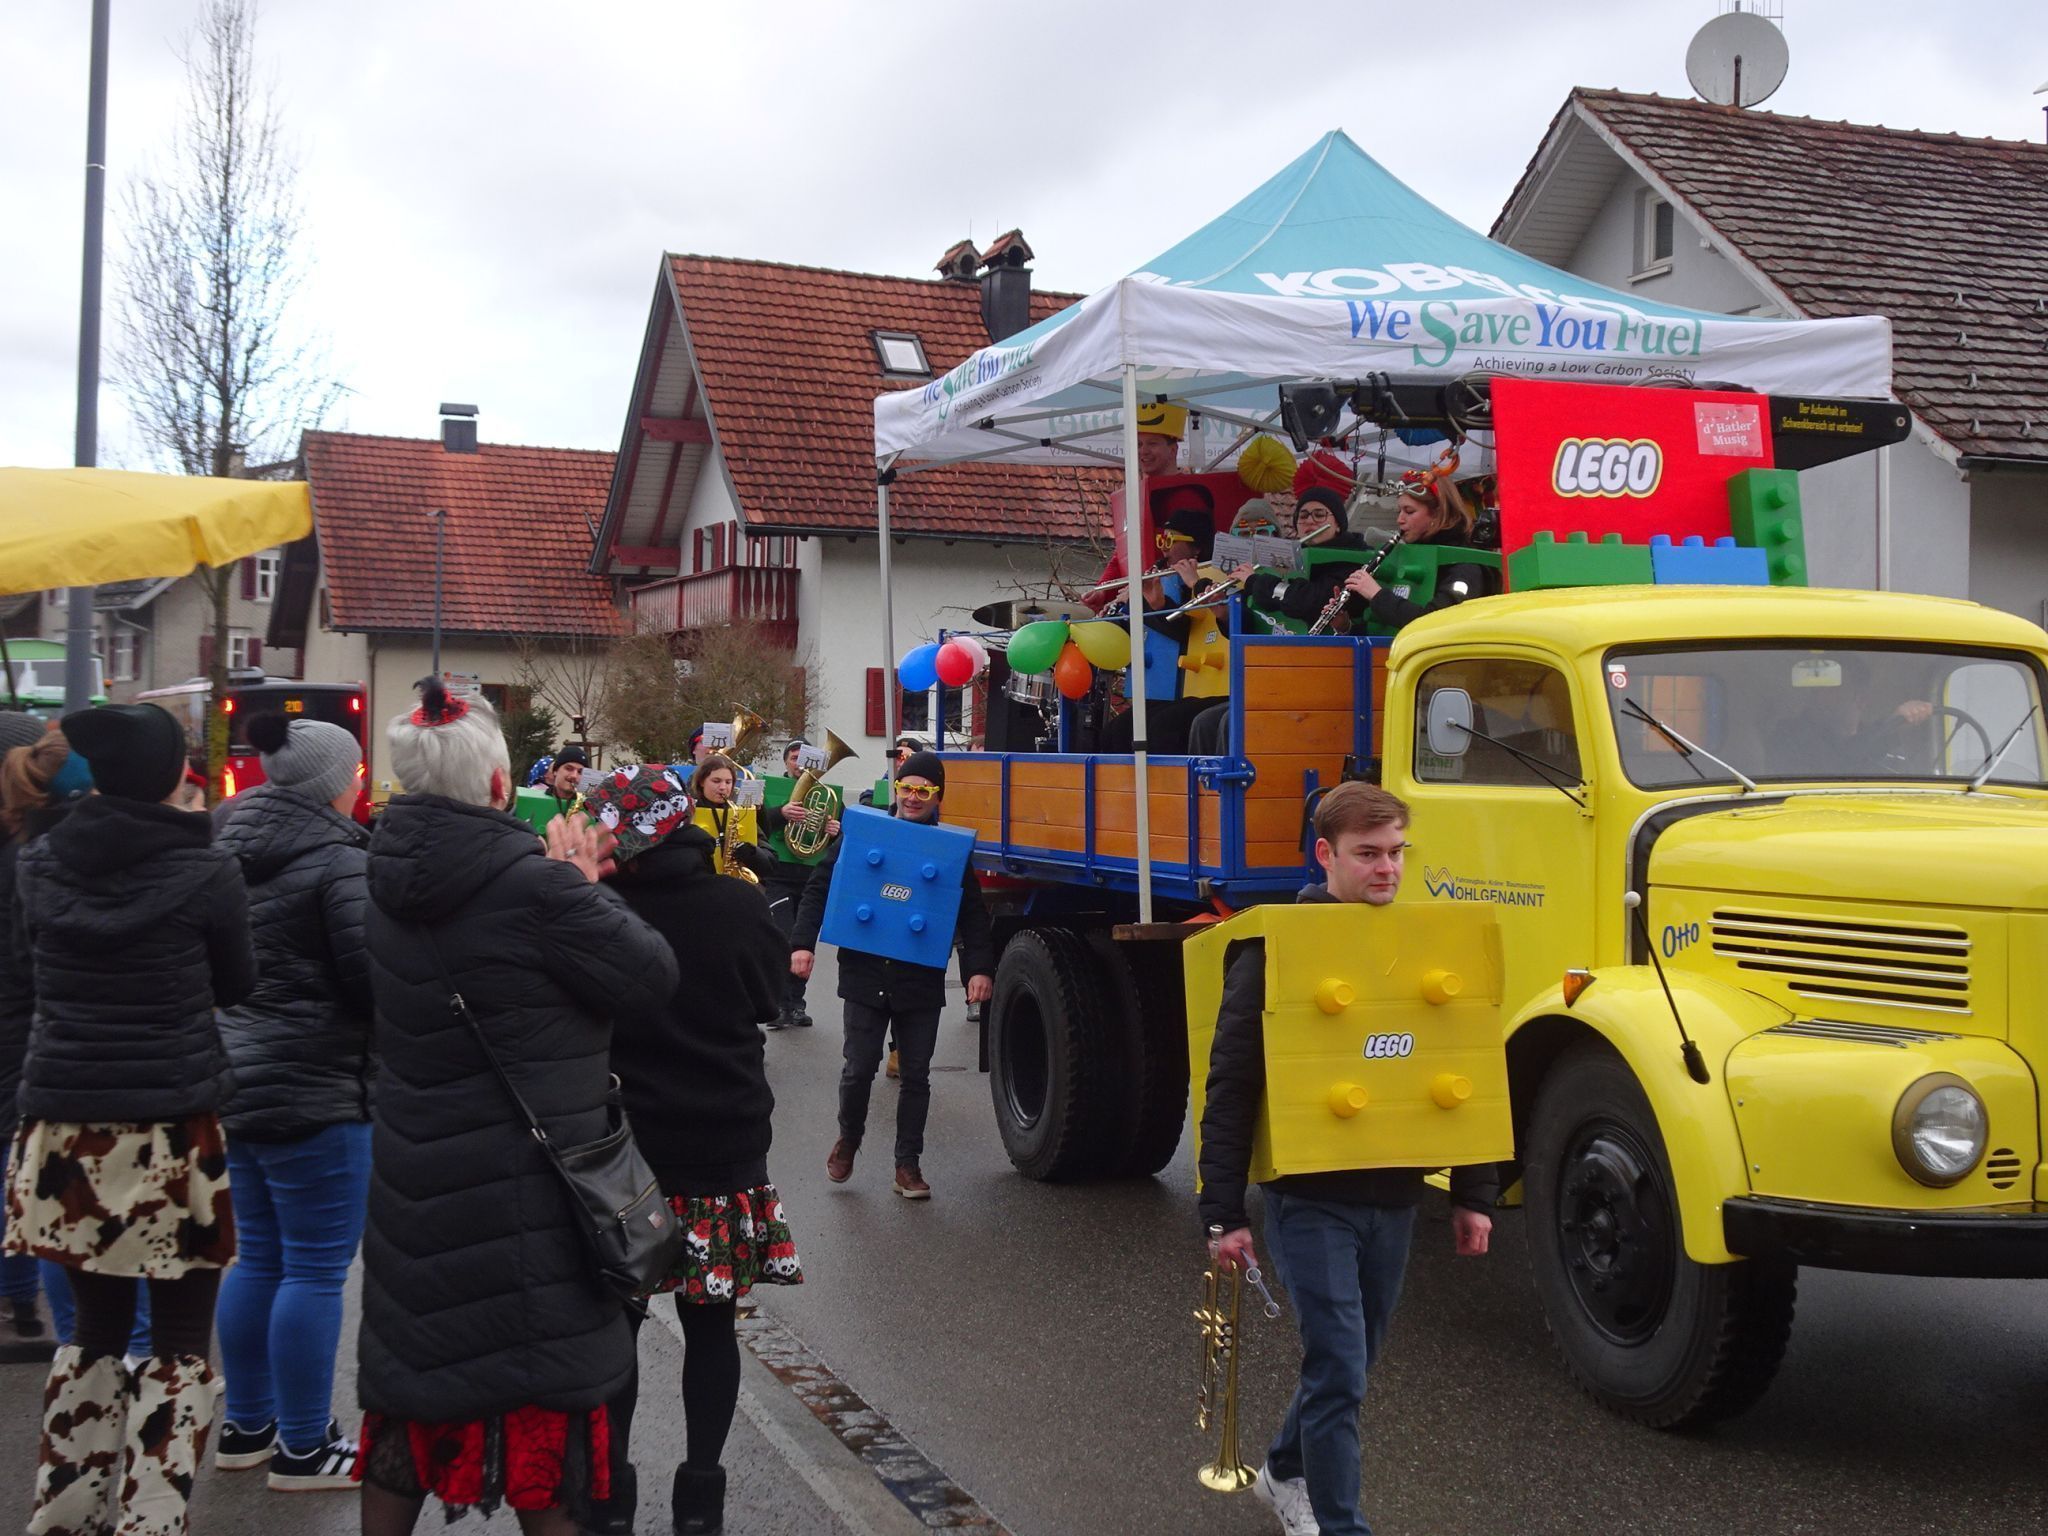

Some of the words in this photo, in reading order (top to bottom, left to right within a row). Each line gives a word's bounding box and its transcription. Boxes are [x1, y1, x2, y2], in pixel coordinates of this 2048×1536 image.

[1346, 300, 1412, 341] We
[1413, 301, 1531, 368] Save
[1534, 303, 1609, 351] You
[1614, 312, 1703, 358] Fuel
[1473, 356, 1545, 373] Achieving
[1548, 362, 1557, 372] a
[1561, 361, 1591, 374] Low
[1594, 363, 1643, 377] Carbon
[1648, 365, 1696, 380] Society
[1716, 421, 1752, 433] Hatler
[1712, 433, 1748, 447] Musig
[1555, 441, 1660, 494] LEGO
[881, 884, 911, 900] LEGO
[1662, 922, 1700, 958] Otto
[1363, 1033, 1415, 1059] LEGO
